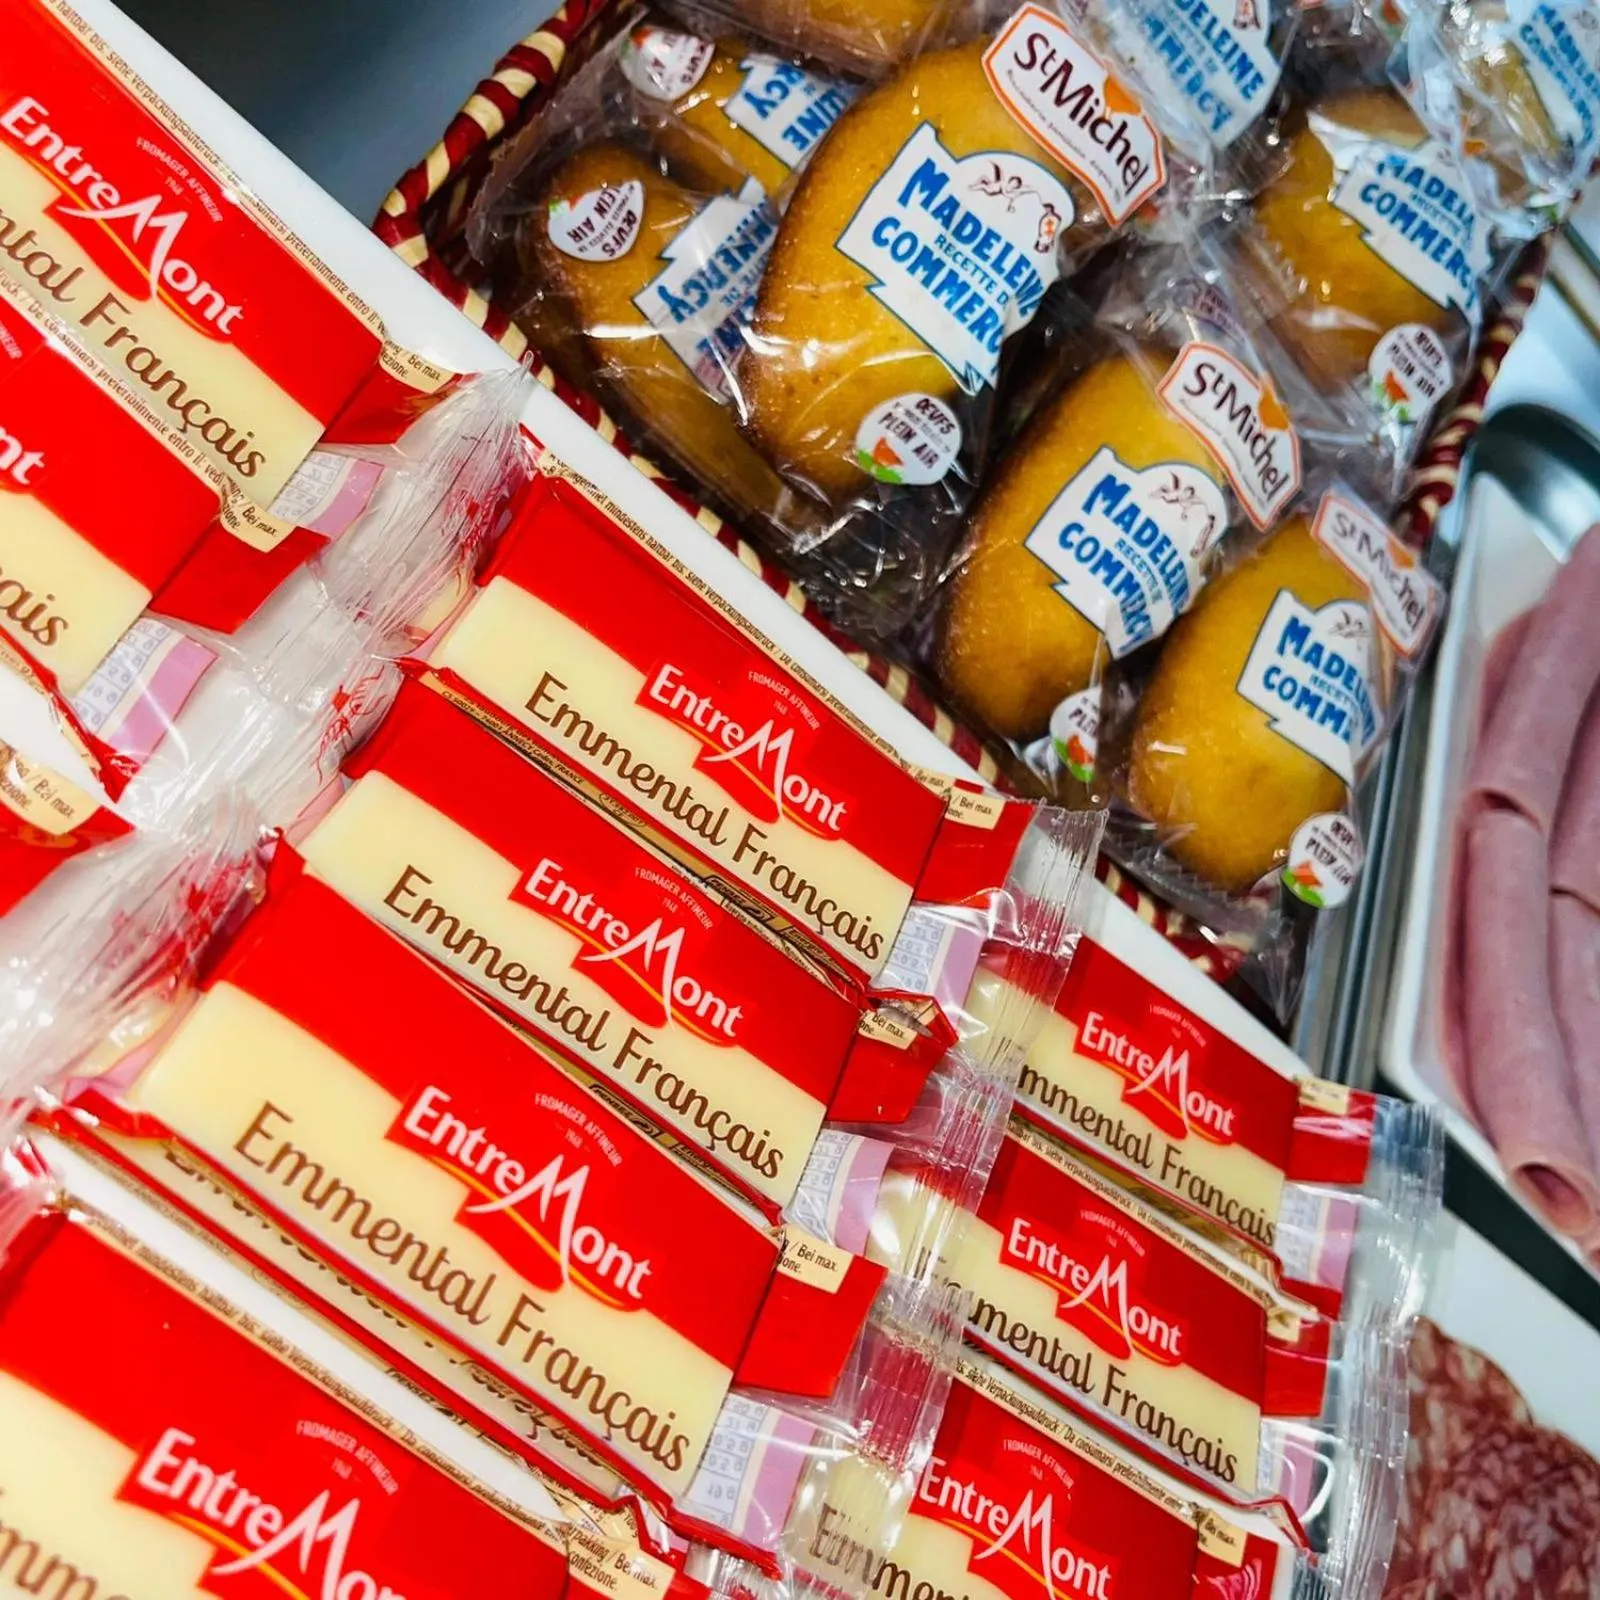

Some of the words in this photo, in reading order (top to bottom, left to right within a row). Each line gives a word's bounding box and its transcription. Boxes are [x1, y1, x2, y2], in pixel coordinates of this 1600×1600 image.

[1, 96, 244, 335] EntreMont
[566, 216, 596, 245] AIR
[933, 233, 998, 295] RECETTE
[871, 216, 1006, 357] COMMERC
[79, 292, 266, 478] Français
[877, 410, 918, 445] PLEIN
[911, 442, 940, 471] AIR
[554, 762, 584, 785] FRANCE
[648, 662, 849, 833] EntreMont
[524, 671, 728, 846] Emmental
[731, 821, 884, 962] Français
[524, 858, 745, 1038] EntreMont
[635, 866, 681, 897] FROMAGER
[679, 891, 714, 931] AFFINEUR
[383, 864, 612, 1052] Emmental
[612, 1027, 785, 1180] Français
[1080, 1010, 1236, 1137] EntreMont
[535, 1092, 587, 1129] FROMAGER
[583, 1120, 625, 1168] AFFINEUR
[1016, 1062, 1156, 1170] mmental
[403, 1084, 653, 1299] EntreMont
[797, 1243, 817, 1262] Bei
[232, 1100, 497, 1327] Emmental
[495, 1292, 690, 1472] Français
[966, 1296, 1096, 1396] mental
[1007, 1217, 1184, 1358] EntreMont
[295, 1419, 358, 1454] FROMAGER
[353, 1445, 400, 1496] AFFINEUR
[918, 1455, 1113, 1600] EntreMont
